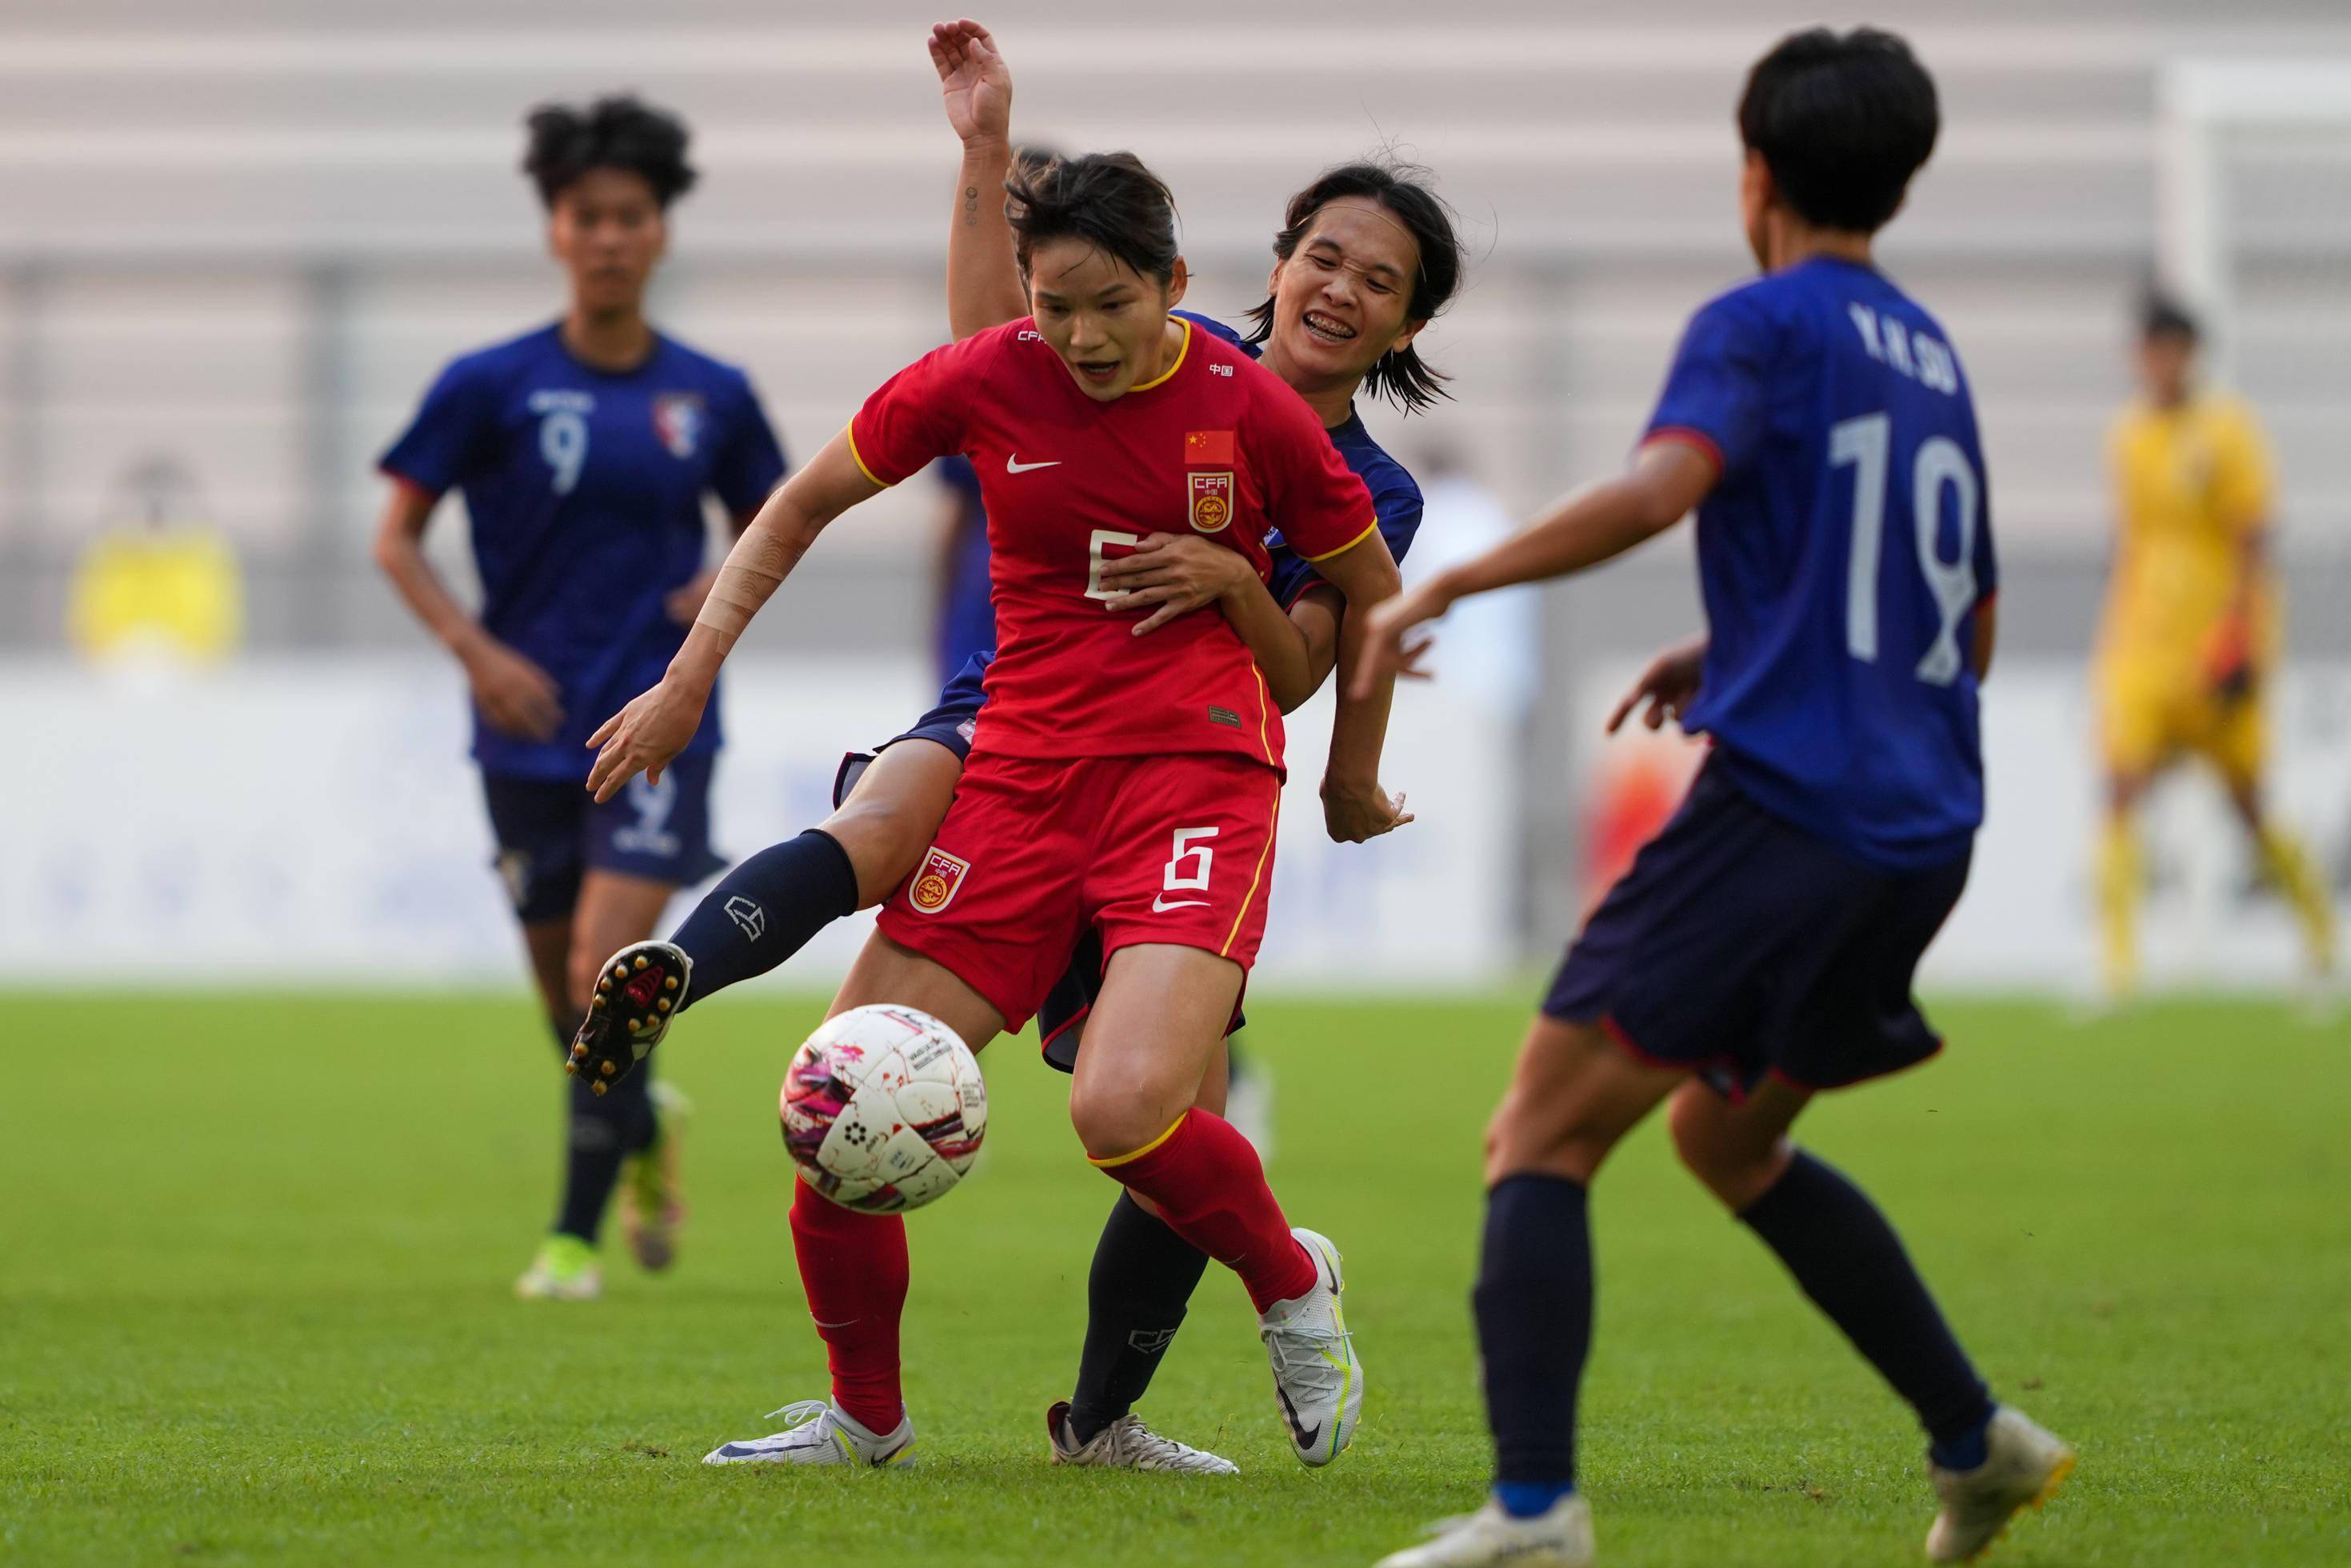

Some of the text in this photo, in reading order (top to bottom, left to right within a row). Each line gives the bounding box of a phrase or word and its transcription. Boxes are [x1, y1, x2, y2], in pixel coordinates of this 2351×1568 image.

[1209, 363, 1233, 377] 中国
[540, 412, 587, 494] 9
[1194, 478, 1228, 489] CFA
[1828, 411, 1979, 687] 19
[930, 854, 962, 876] CFA
[1163, 826, 1220, 891] 6
